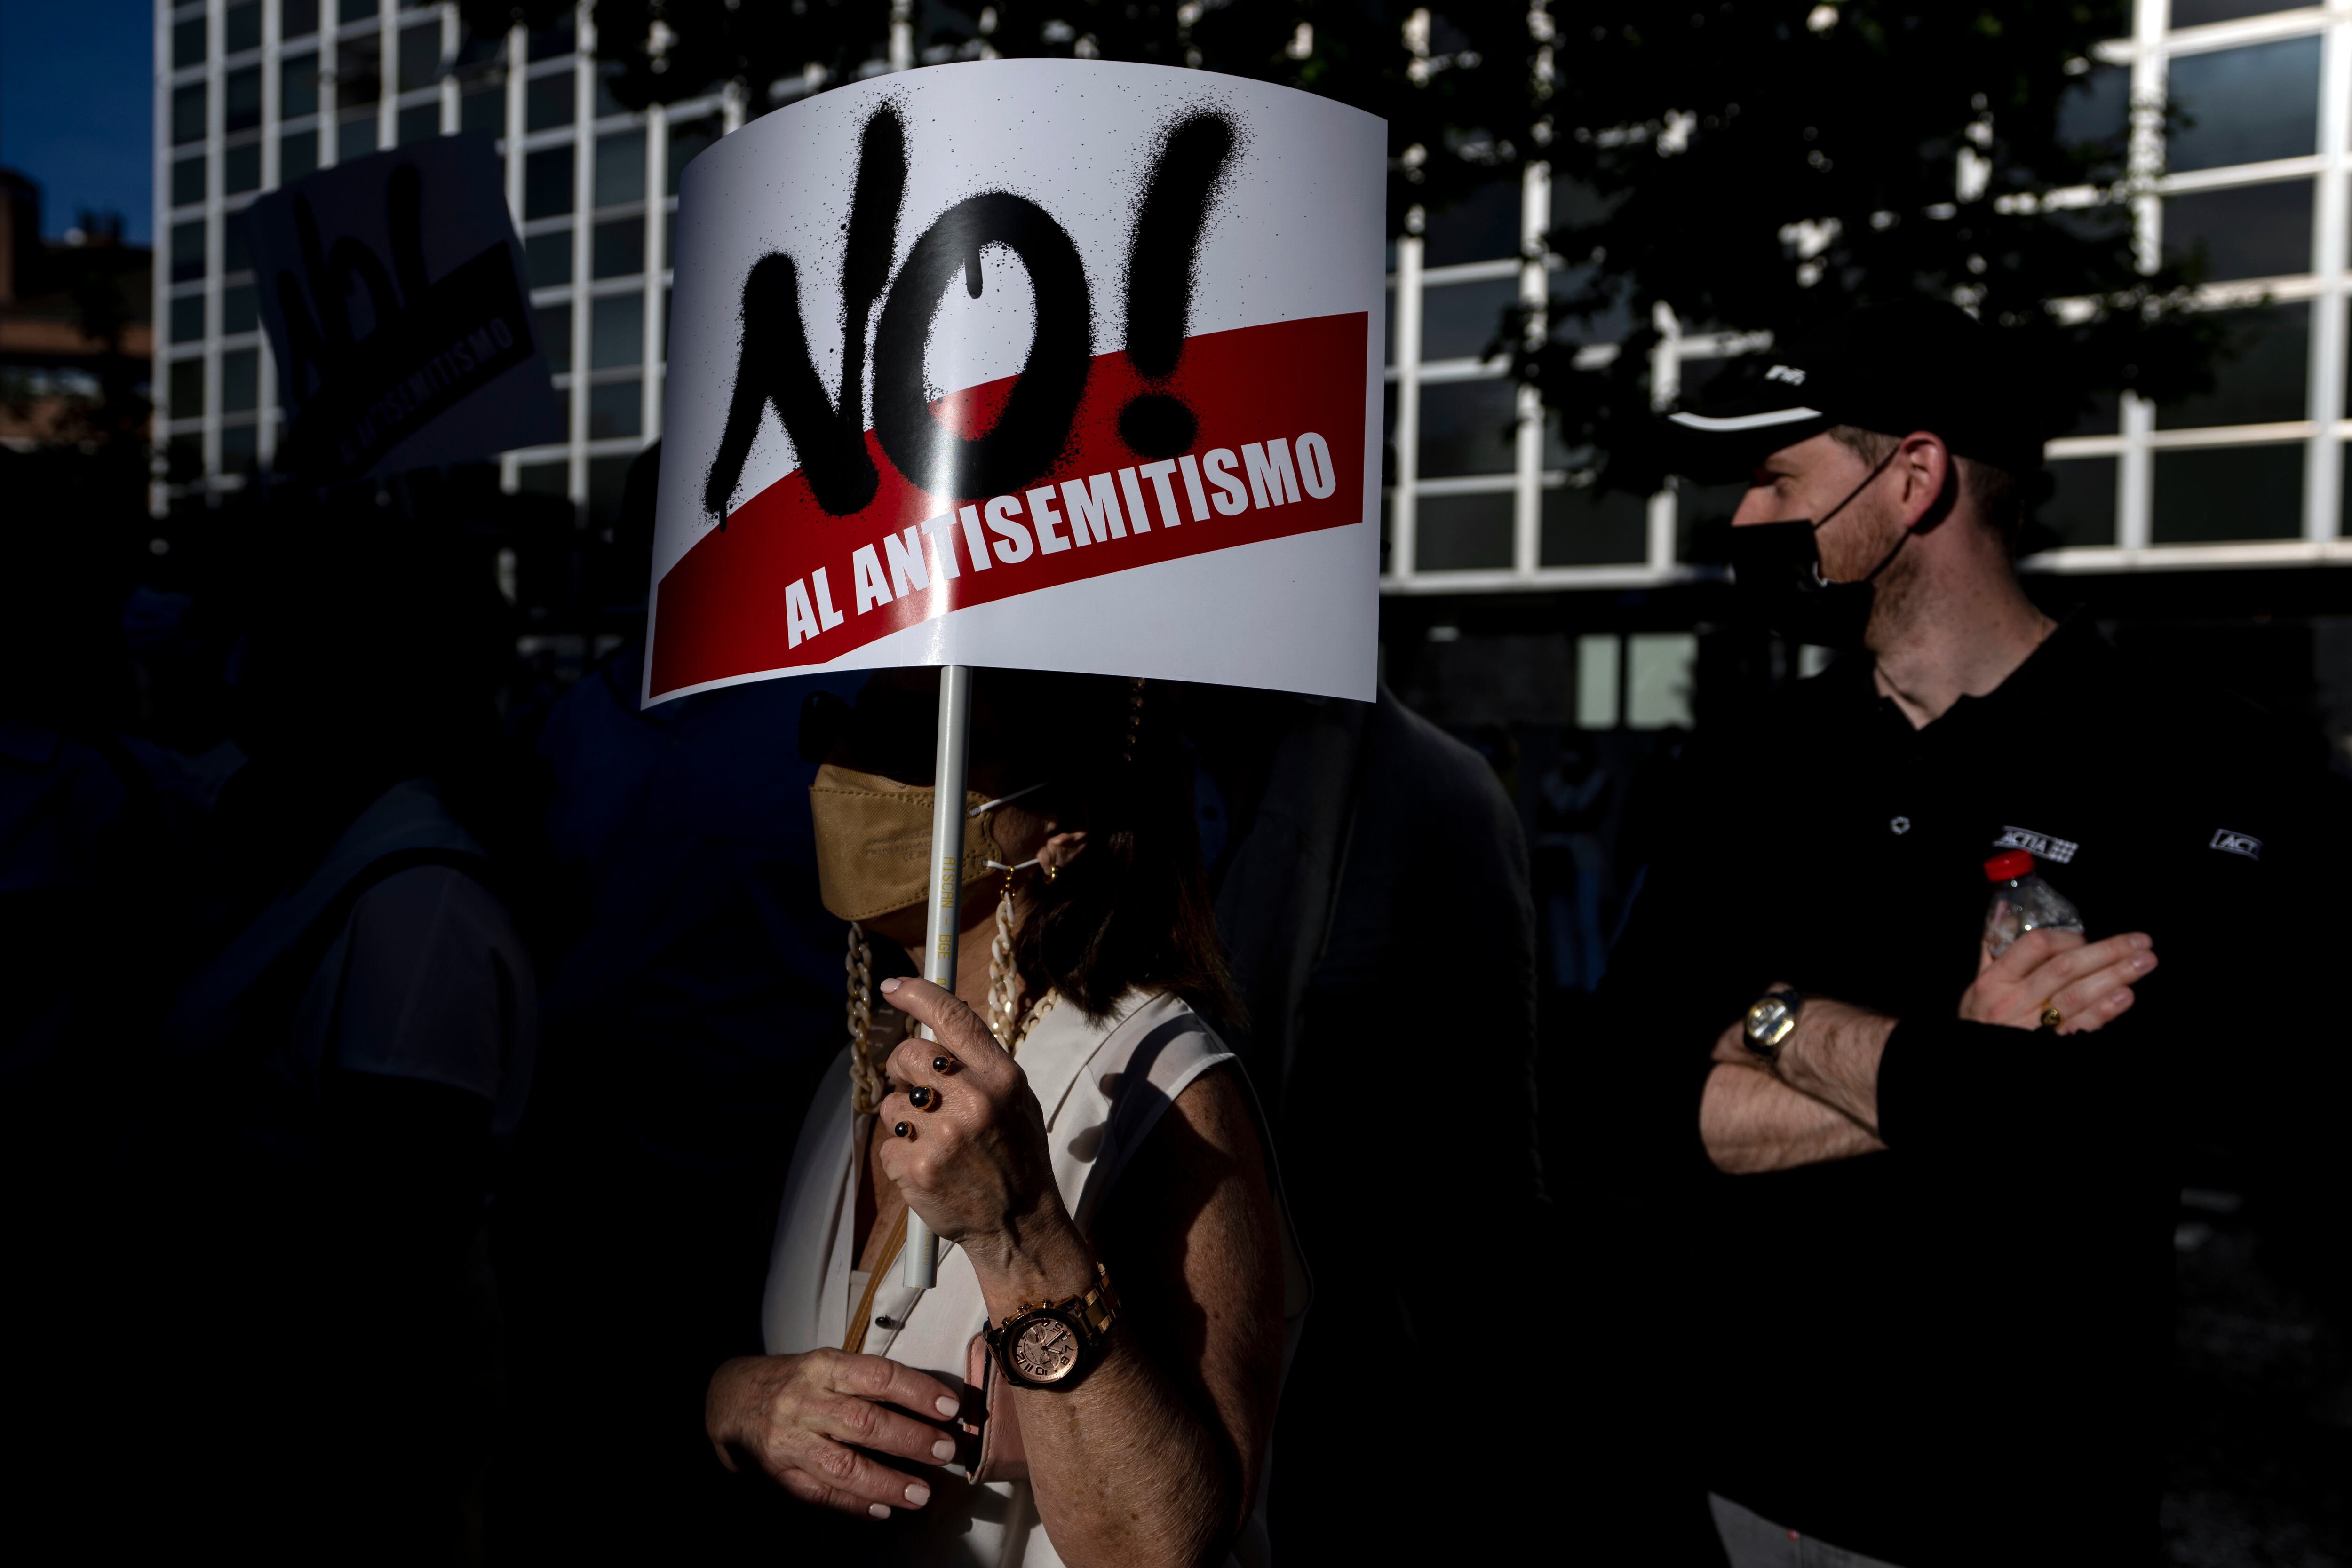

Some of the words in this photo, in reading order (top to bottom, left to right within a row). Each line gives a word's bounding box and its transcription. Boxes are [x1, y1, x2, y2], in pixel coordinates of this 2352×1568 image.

[706, 99, 1236, 532] NO!
[784, 566, 844, 650] AL
[852, 431, 1337, 616] ANTISEMITISMO
[938, 934, 952, 960] BGE
[940, 856, 957, 909] AISCAN
